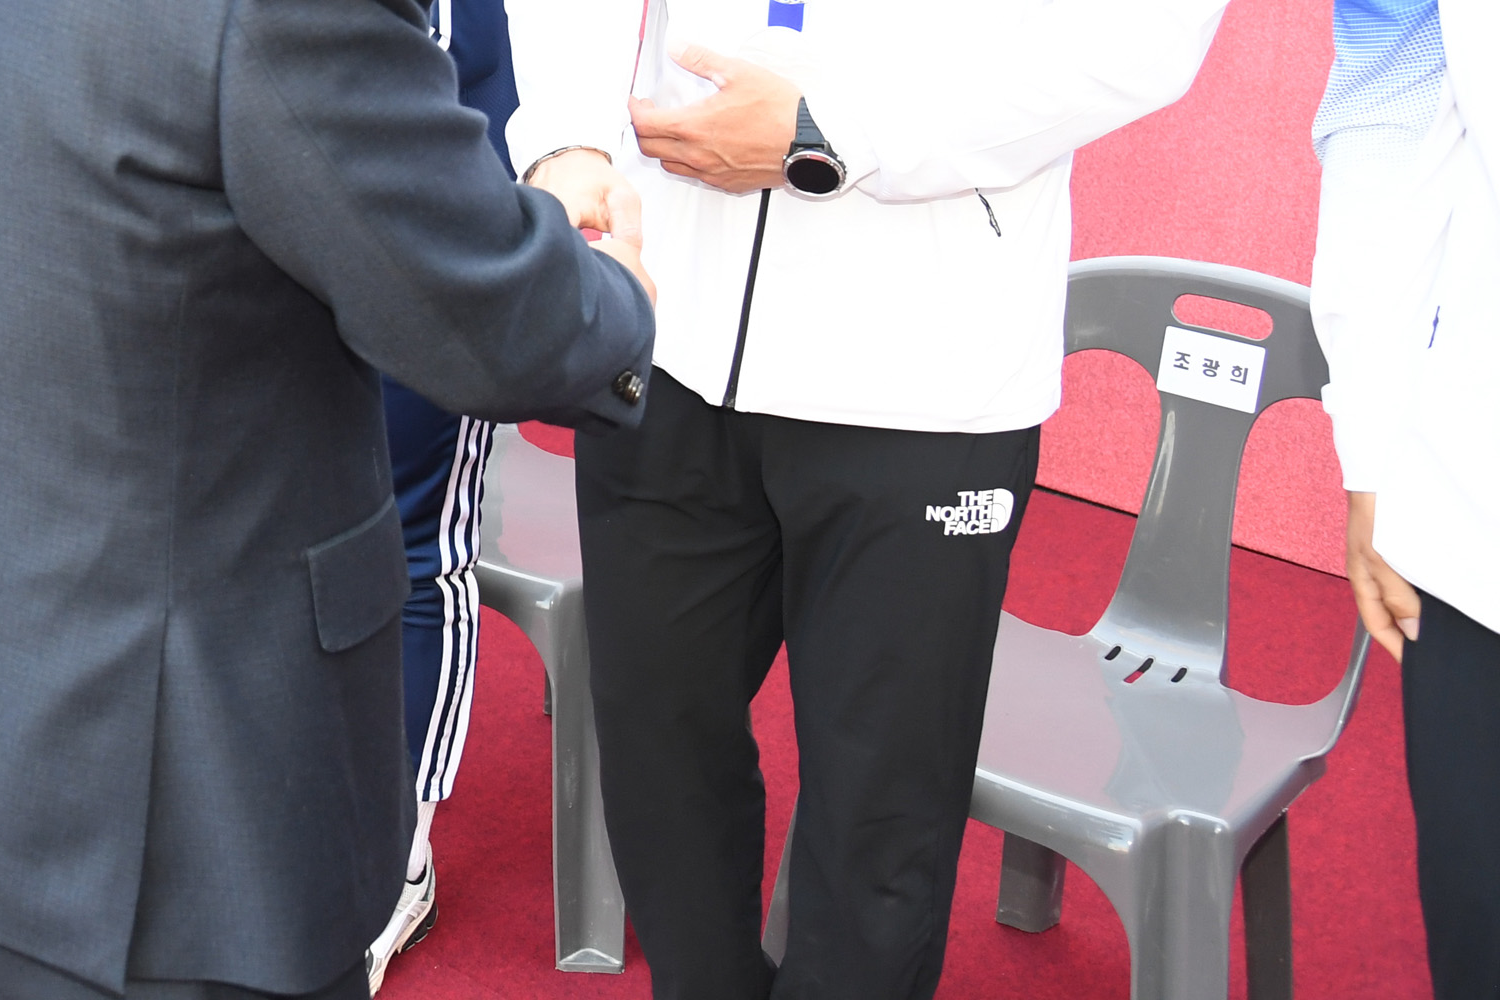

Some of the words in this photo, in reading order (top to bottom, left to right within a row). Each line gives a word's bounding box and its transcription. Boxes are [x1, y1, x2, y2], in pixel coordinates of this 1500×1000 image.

[957, 489, 994, 507] THE
[925, 503, 993, 522] NORTH
[943, 518, 991, 536] FACE
